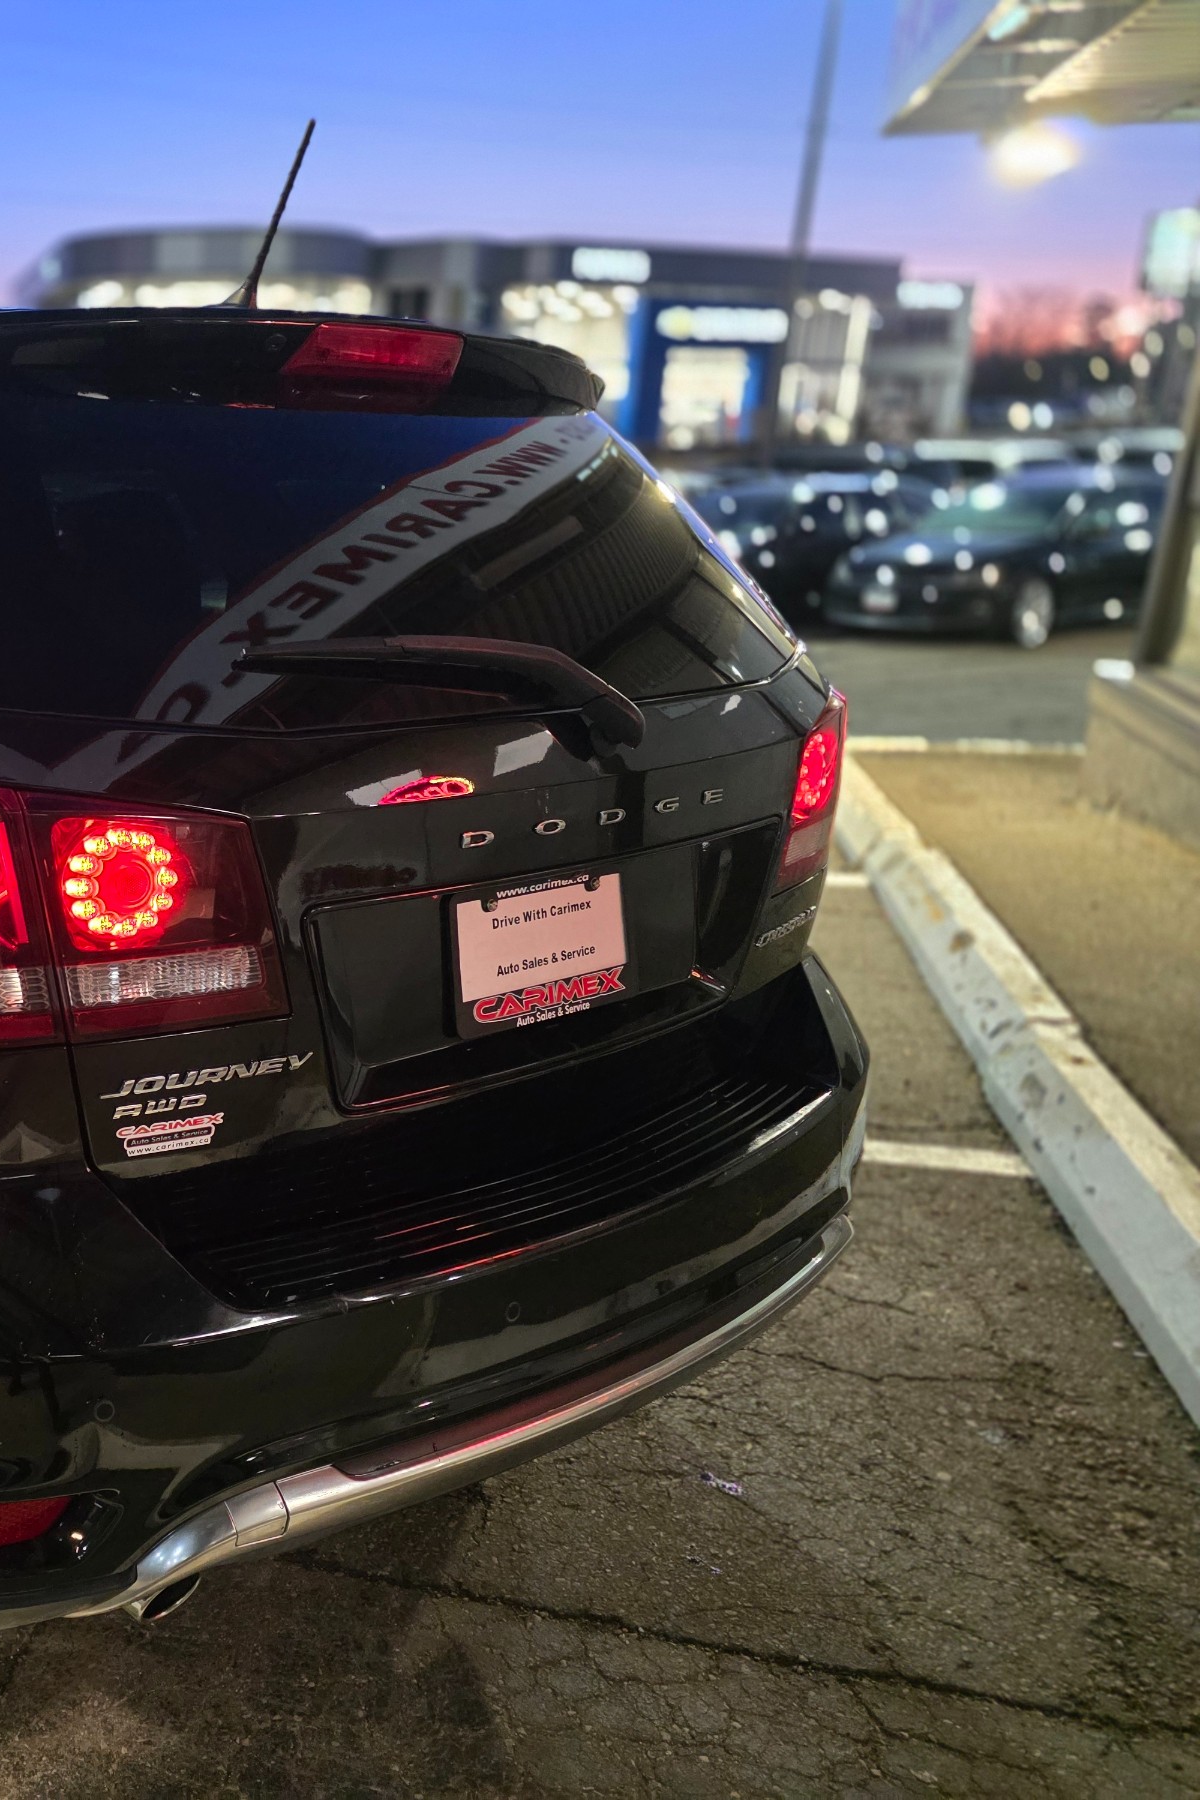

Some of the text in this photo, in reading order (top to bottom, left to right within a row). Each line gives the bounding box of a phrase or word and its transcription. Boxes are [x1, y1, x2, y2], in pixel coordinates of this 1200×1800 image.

[460, 788, 724, 850] DODGE
[496, 874, 590, 899] www.carimex.ca
[492, 900, 592, 930] Drive With Carimex
[496, 945, 596, 977] Auto Sales & Service
[473, 966, 626, 1023] CARIMEX
[516, 1002, 591, 1028] Auto Sales & Service
[100, 1051, 314, 1100] JOURNEY
[112, 1093, 208, 1120] AWD
[117, 1113, 223, 1137] CARIMEX
[130, 1138, 149, 1146] Auto
[151, 1135, 172, 1143] Sales
[181, 1129, 209, 1138] Service
[128, 1137, 210, 1155] www.carimex.ca
